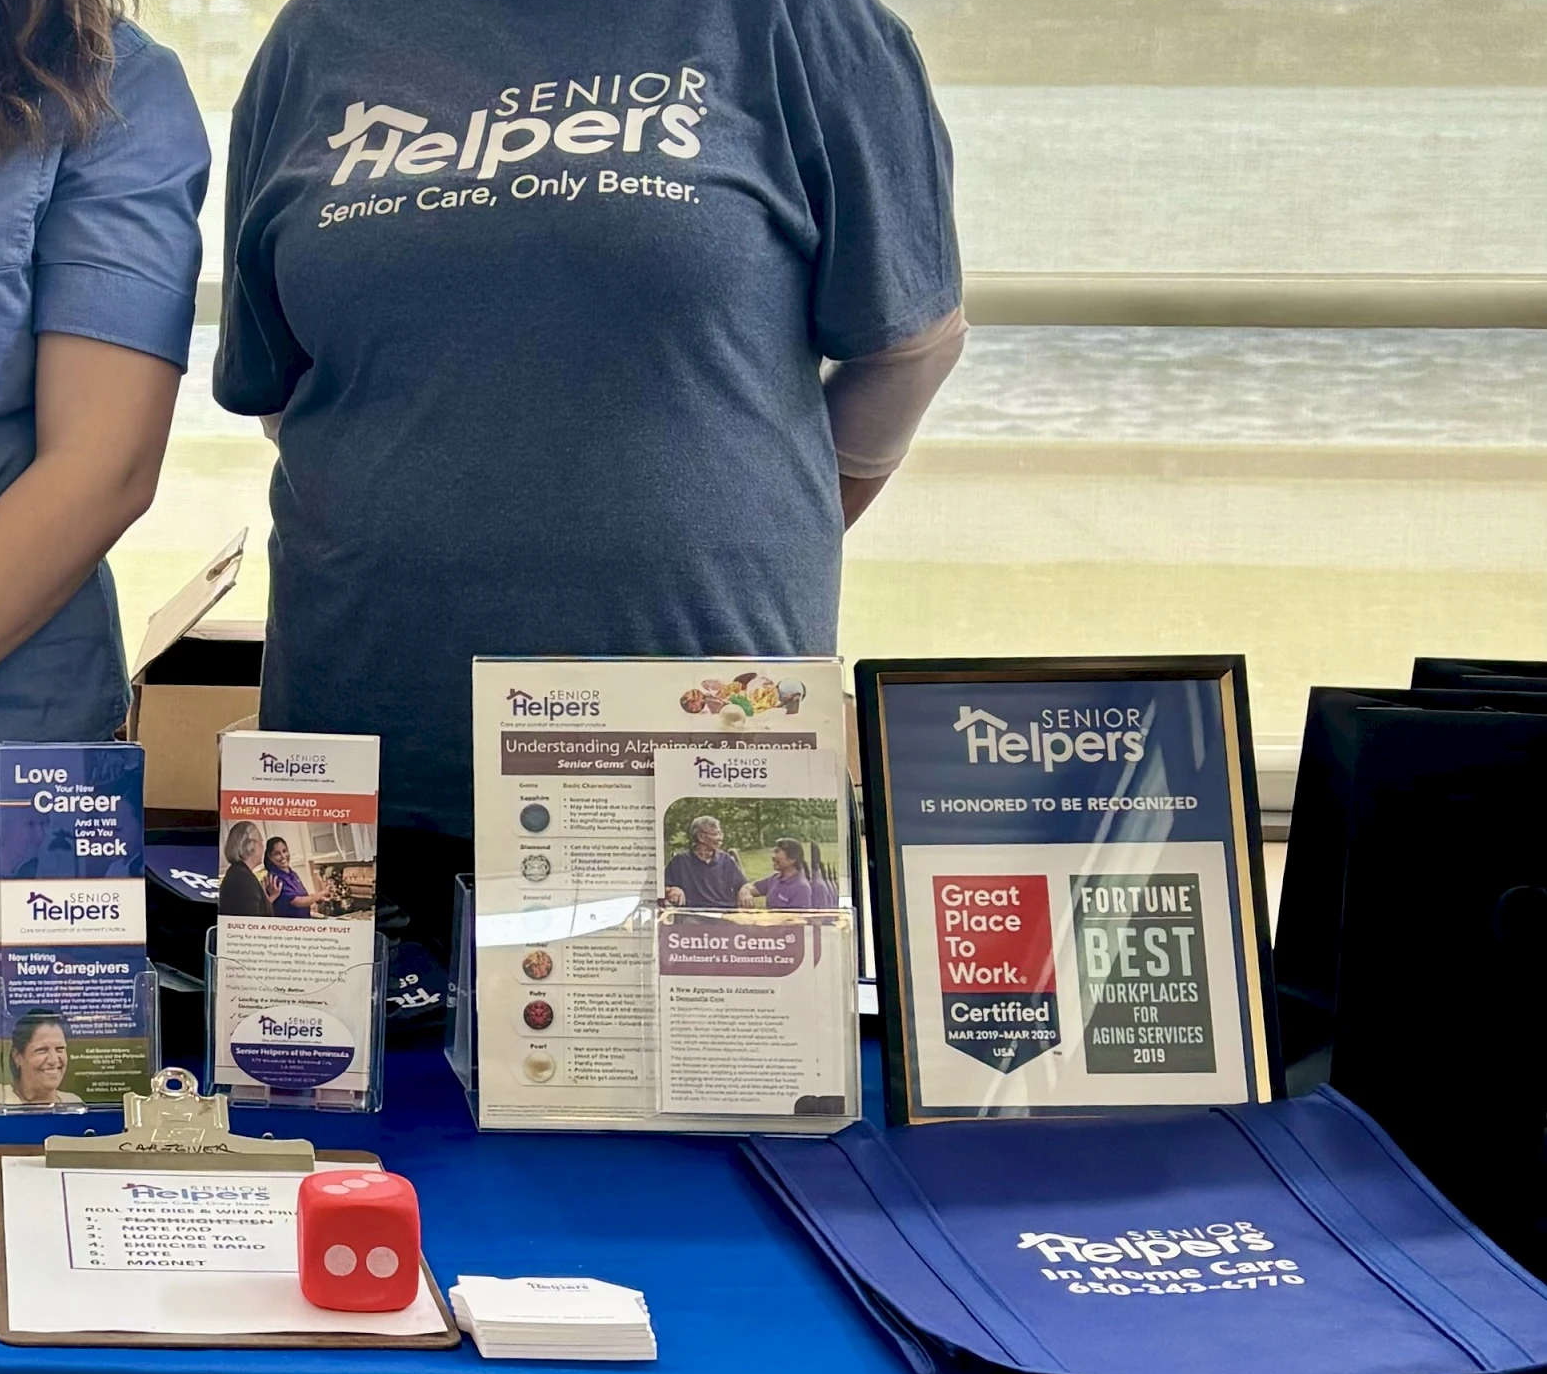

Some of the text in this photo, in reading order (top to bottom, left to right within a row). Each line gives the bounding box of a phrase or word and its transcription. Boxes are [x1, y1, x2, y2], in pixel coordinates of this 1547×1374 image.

[494, 66, 707, 117] SENIOR
[330, 102, 702, 186] Helpers
[317, 170, 701, 228] Senior Care, Only Better.
[550, 689, 600, 701] SENIOR
[511, 697, 600, 721] Helpers
[1042, 708, 1142, 729] SENIOR
[506, 739, 620, 756] Understanding
[966, 722, 1144, 772] Helpers
[14, 765, 68, 785] Love
[698, 763, 768, 781] Helpers
[33, 791, 121, 813] Career
[231, 797, 317, 807] A HELPING HAND
[921, 796, 1198, 813] IS HONORED TO BE RECOGNIZED
[231, 806, 351, 818] WHEN YOU NEED IT MOST
[76, 839, 127, 856] Back
[70, 892, 120, 904] SENIOR
[941, 884, 1021, 907] Great
[1081, 886, 1192, 914] FORTUNE
[32, 900, 120, 925] Helpers
[945, 910, 1022, 933] Place
[668, 933, 730, 951] Senior
[945, 936, 976, 959] To
[669, 953, 795, 965] Alzheimer's & Dementia Care
[1084, 926, 1195, 979] BEST
[17, 961, 130, 977] New Caregivers
[1089, 983, 1199, 1004] WORKPLACES
[950, 1001, 1049, 1023] Certified
[1133, 1006, 1159, 1024] FOR
[262, 1021, 323, 1039] Helpers
[949, 1030, 974, 1041] MAR
[1031, 1029, 1056, 1040] 2020
[1092, 1026, 1204, 1045] AGING SERVICES
[236, 1047, 350, 1059] Senior Helpers of the Peninsula
[993, 1047, 1015, 1058] USA
[1133, 1048, 1166, 1064] 2019
[132, 1188, 270, 1201] Helpers
[1127, 1221, 1254, 1242] SENIOR
[1036, 1232, 1274, 1266] Helpers
[1041, 1259, 1298, 1281] In Home Care
